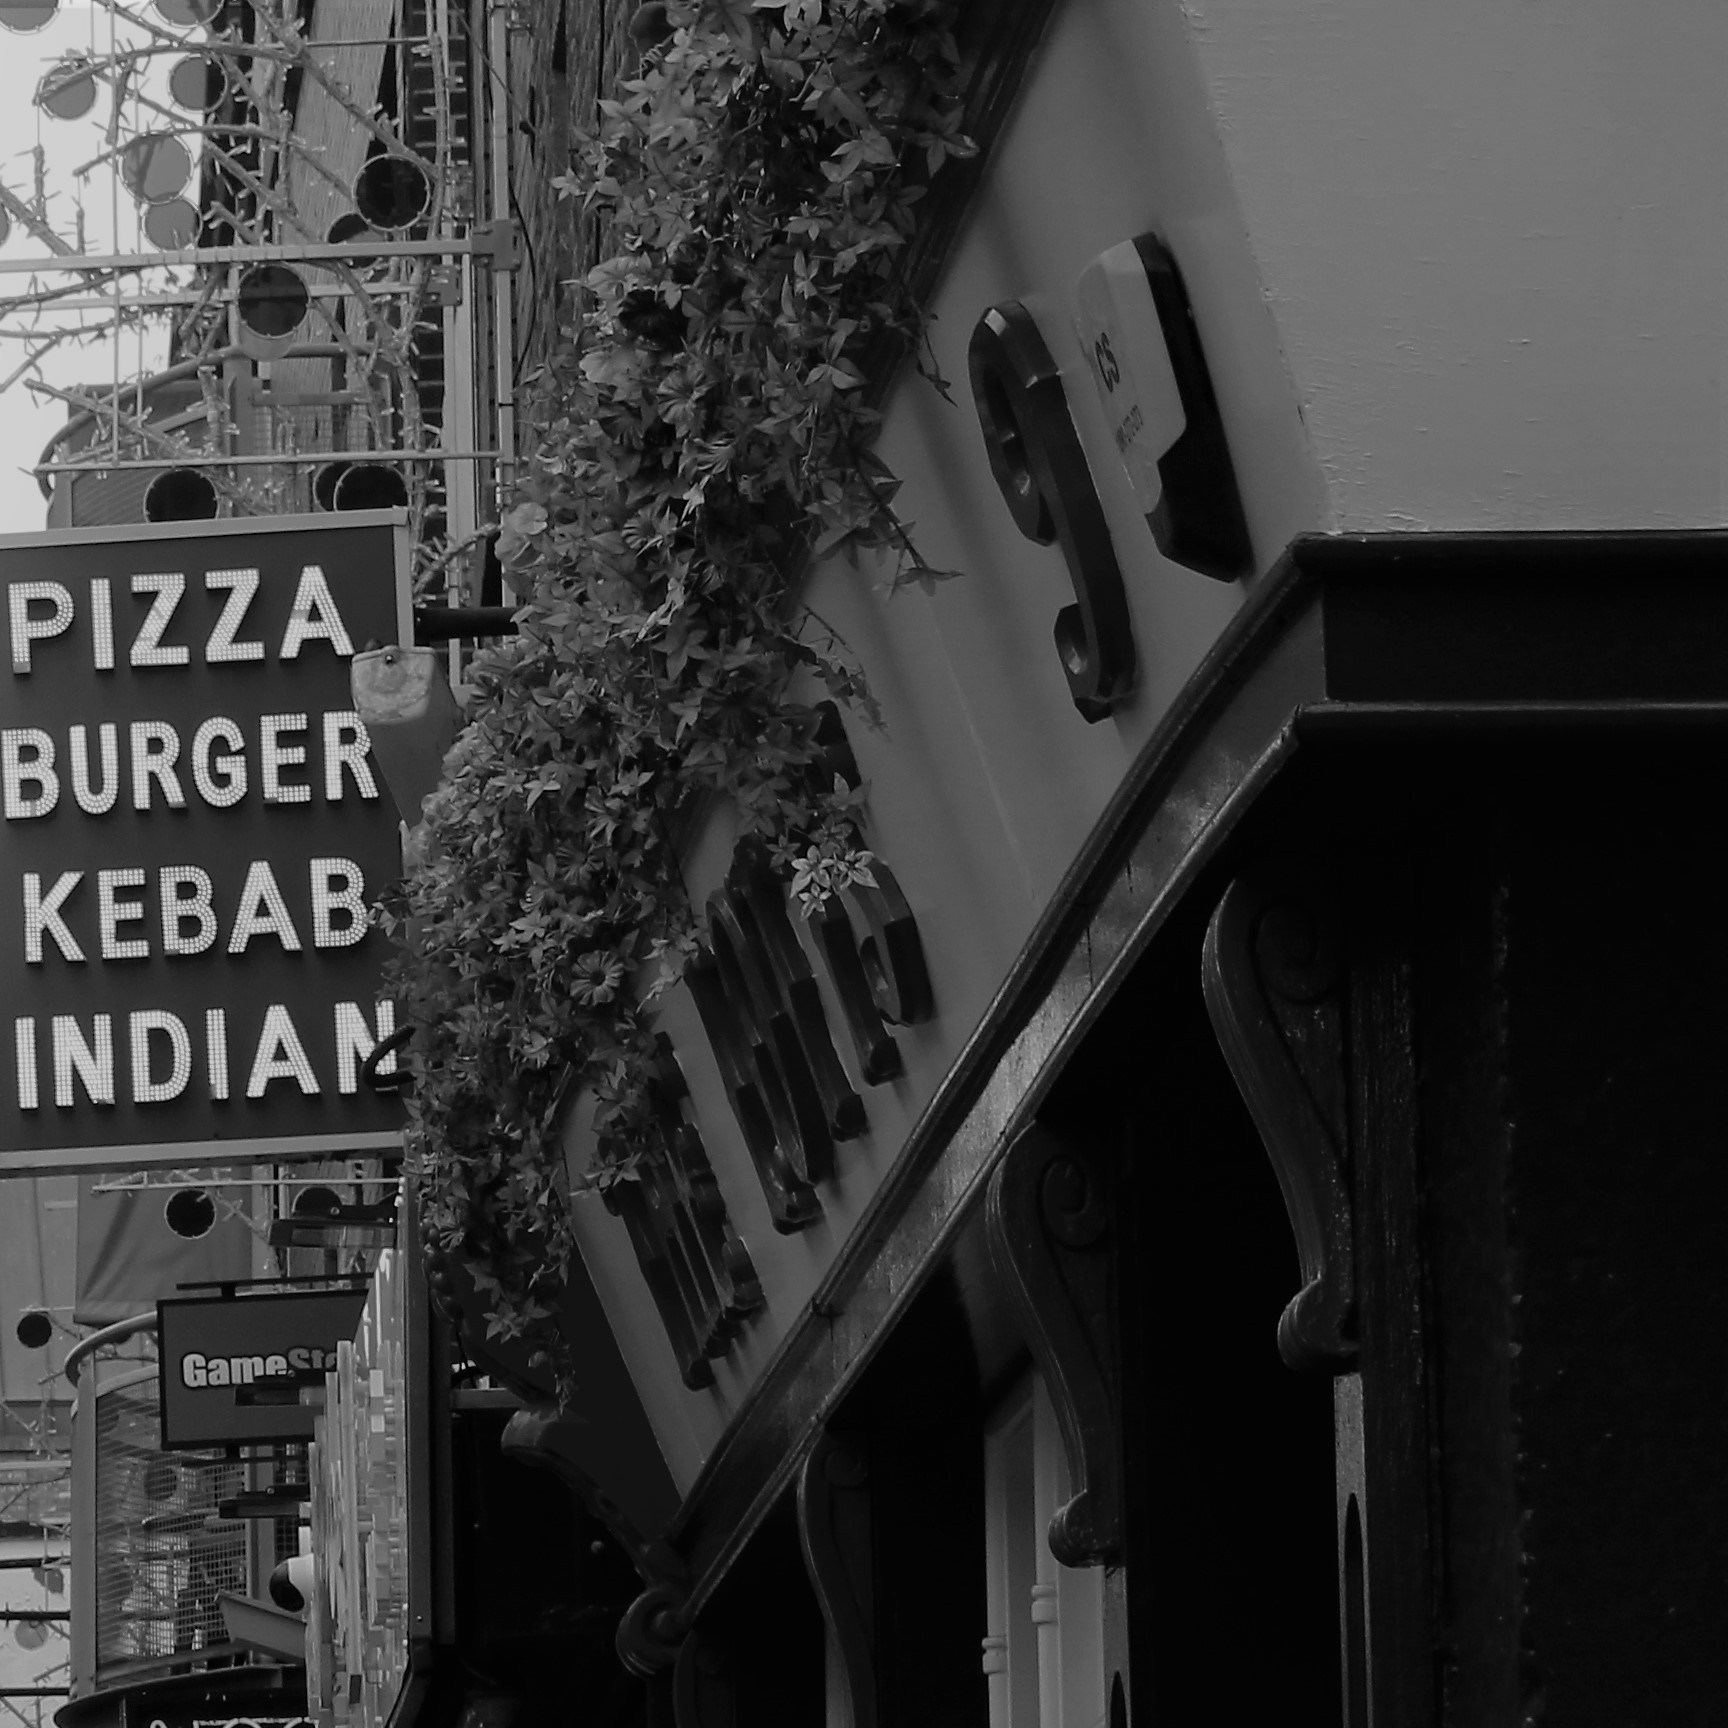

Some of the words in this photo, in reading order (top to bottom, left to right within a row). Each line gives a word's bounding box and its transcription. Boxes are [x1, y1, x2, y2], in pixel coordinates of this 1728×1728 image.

[7, 563, 354, 675] PIZZA
[0, 710, 381, 821] BURGER
[22, 857, 370, 965] KEBAB
[14, 998, 400, 1111] INDIAN
[182, 1347, 337, 1388] GameSt
